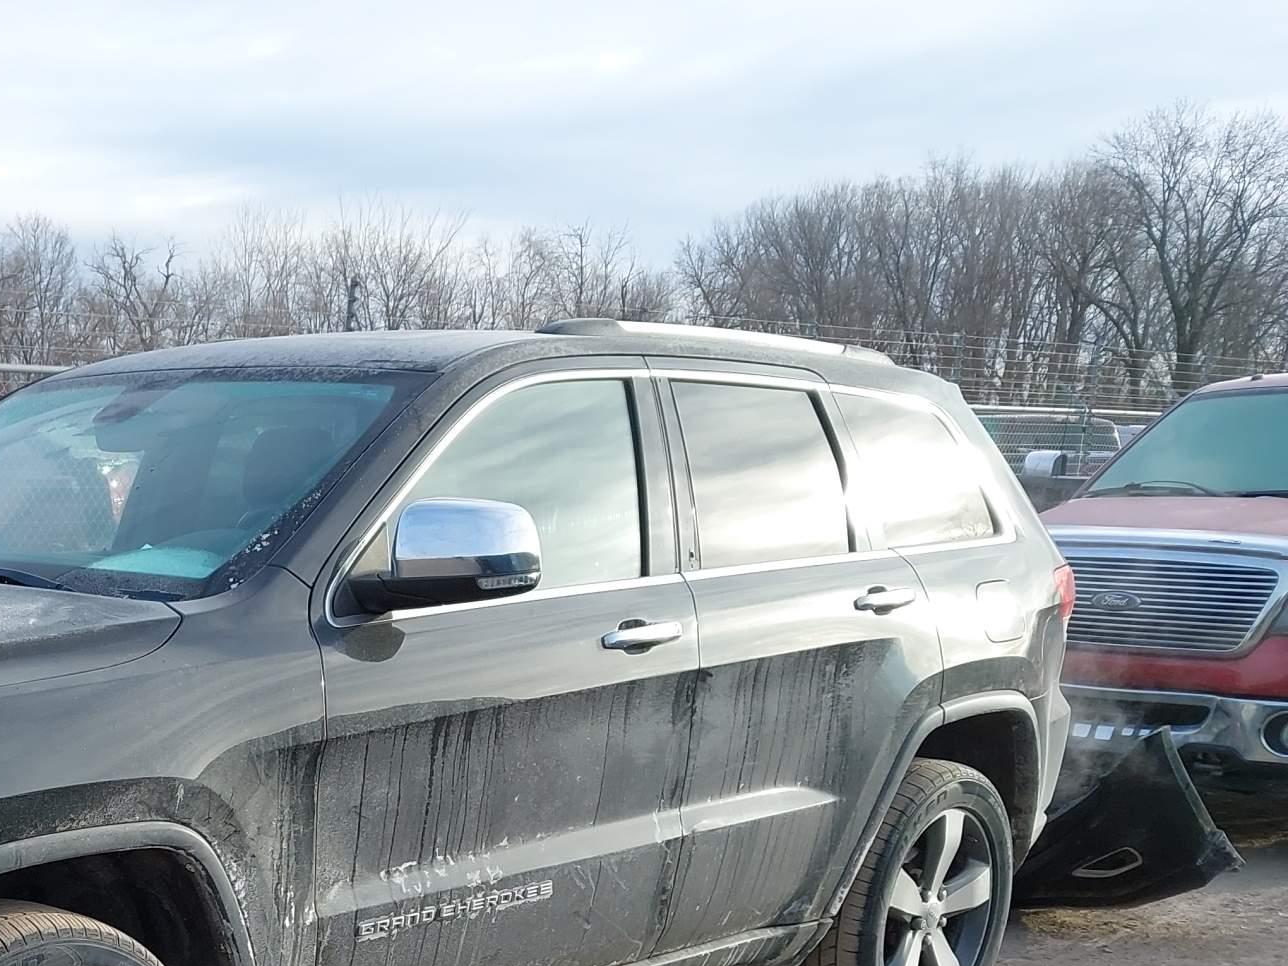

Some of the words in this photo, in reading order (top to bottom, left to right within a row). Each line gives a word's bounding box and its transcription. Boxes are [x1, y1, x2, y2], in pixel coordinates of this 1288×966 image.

[1101, 594, 1130, 608] Ford
[360, 905, 436, 936] GRAND
[441, 880, 553, 918] CHEROKEE
